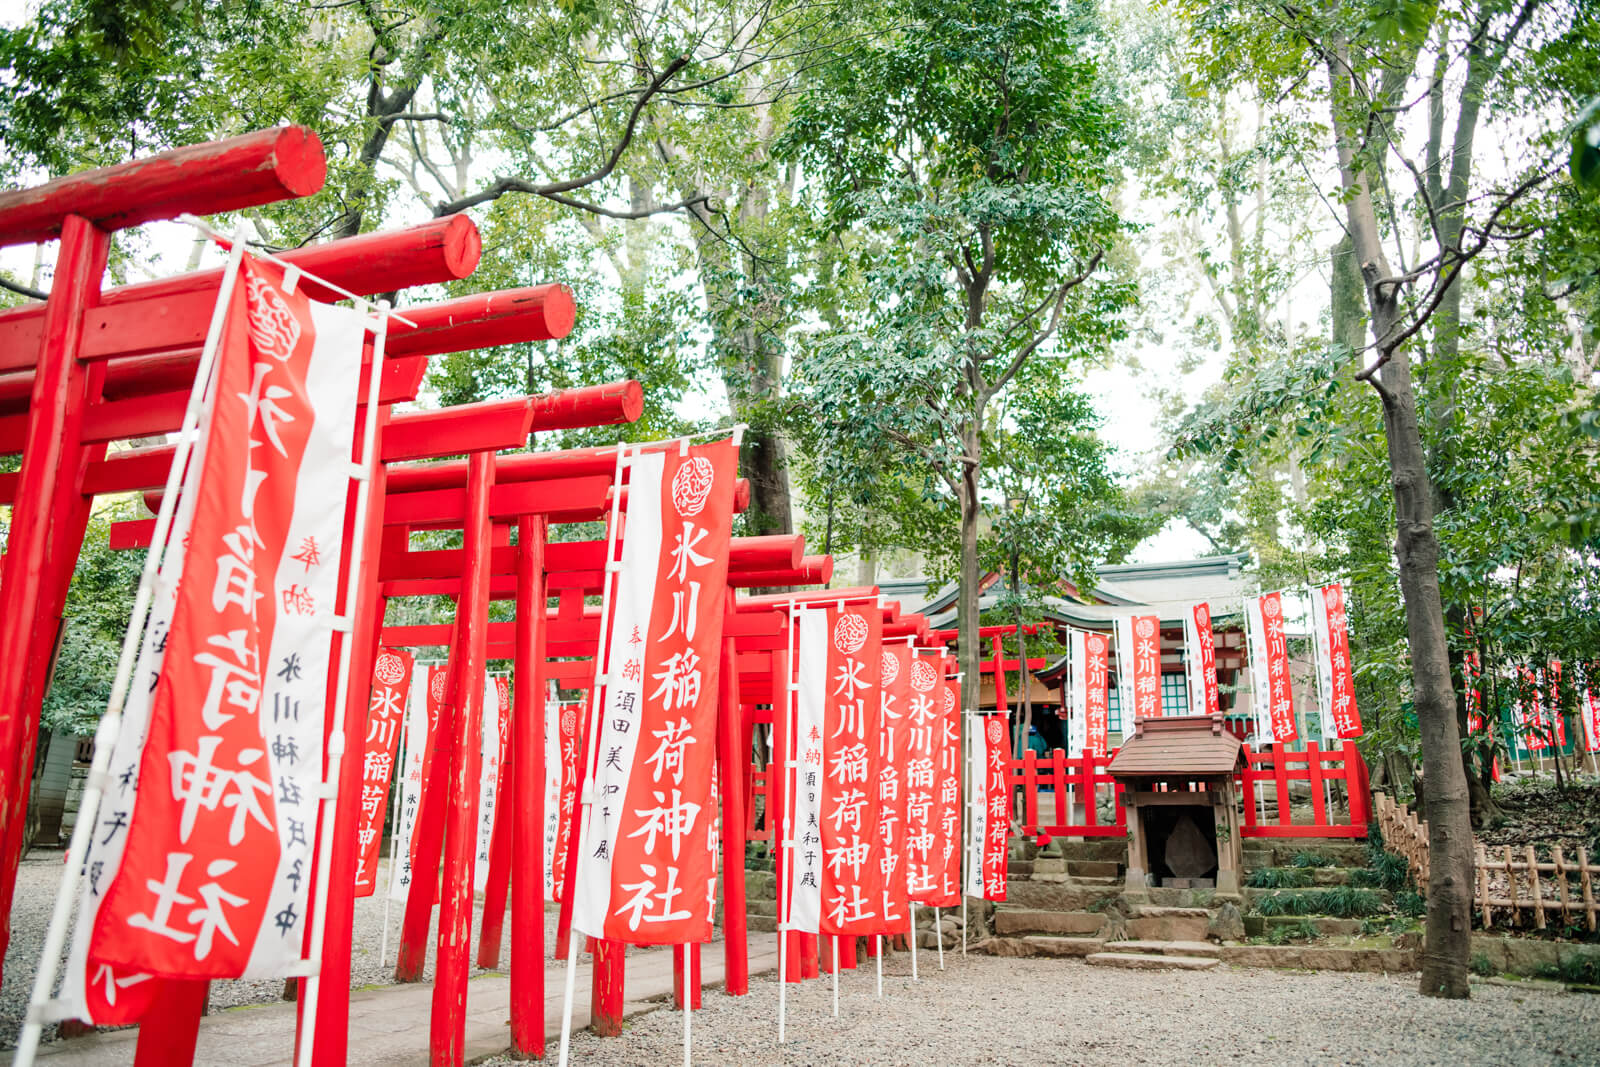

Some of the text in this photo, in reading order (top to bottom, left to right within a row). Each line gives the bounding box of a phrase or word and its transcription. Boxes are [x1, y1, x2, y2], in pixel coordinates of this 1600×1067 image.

[622, 623, 643, 684] 奉納
[1088, 655, 1108, 759] 氷川稲荷神社
[1136, 639, 1159, 718] 氷川稲荷
[614, 521, 715, 932] 氷川稲荷神社
[804, 724, 821, 766] 奉納
[825, 658, 876, 929] 氷川稲荷神社
[906, 694, 938, 896] 氷川稲荷神社
[986, 746, 1008, 897] 氷川稲荷神社
